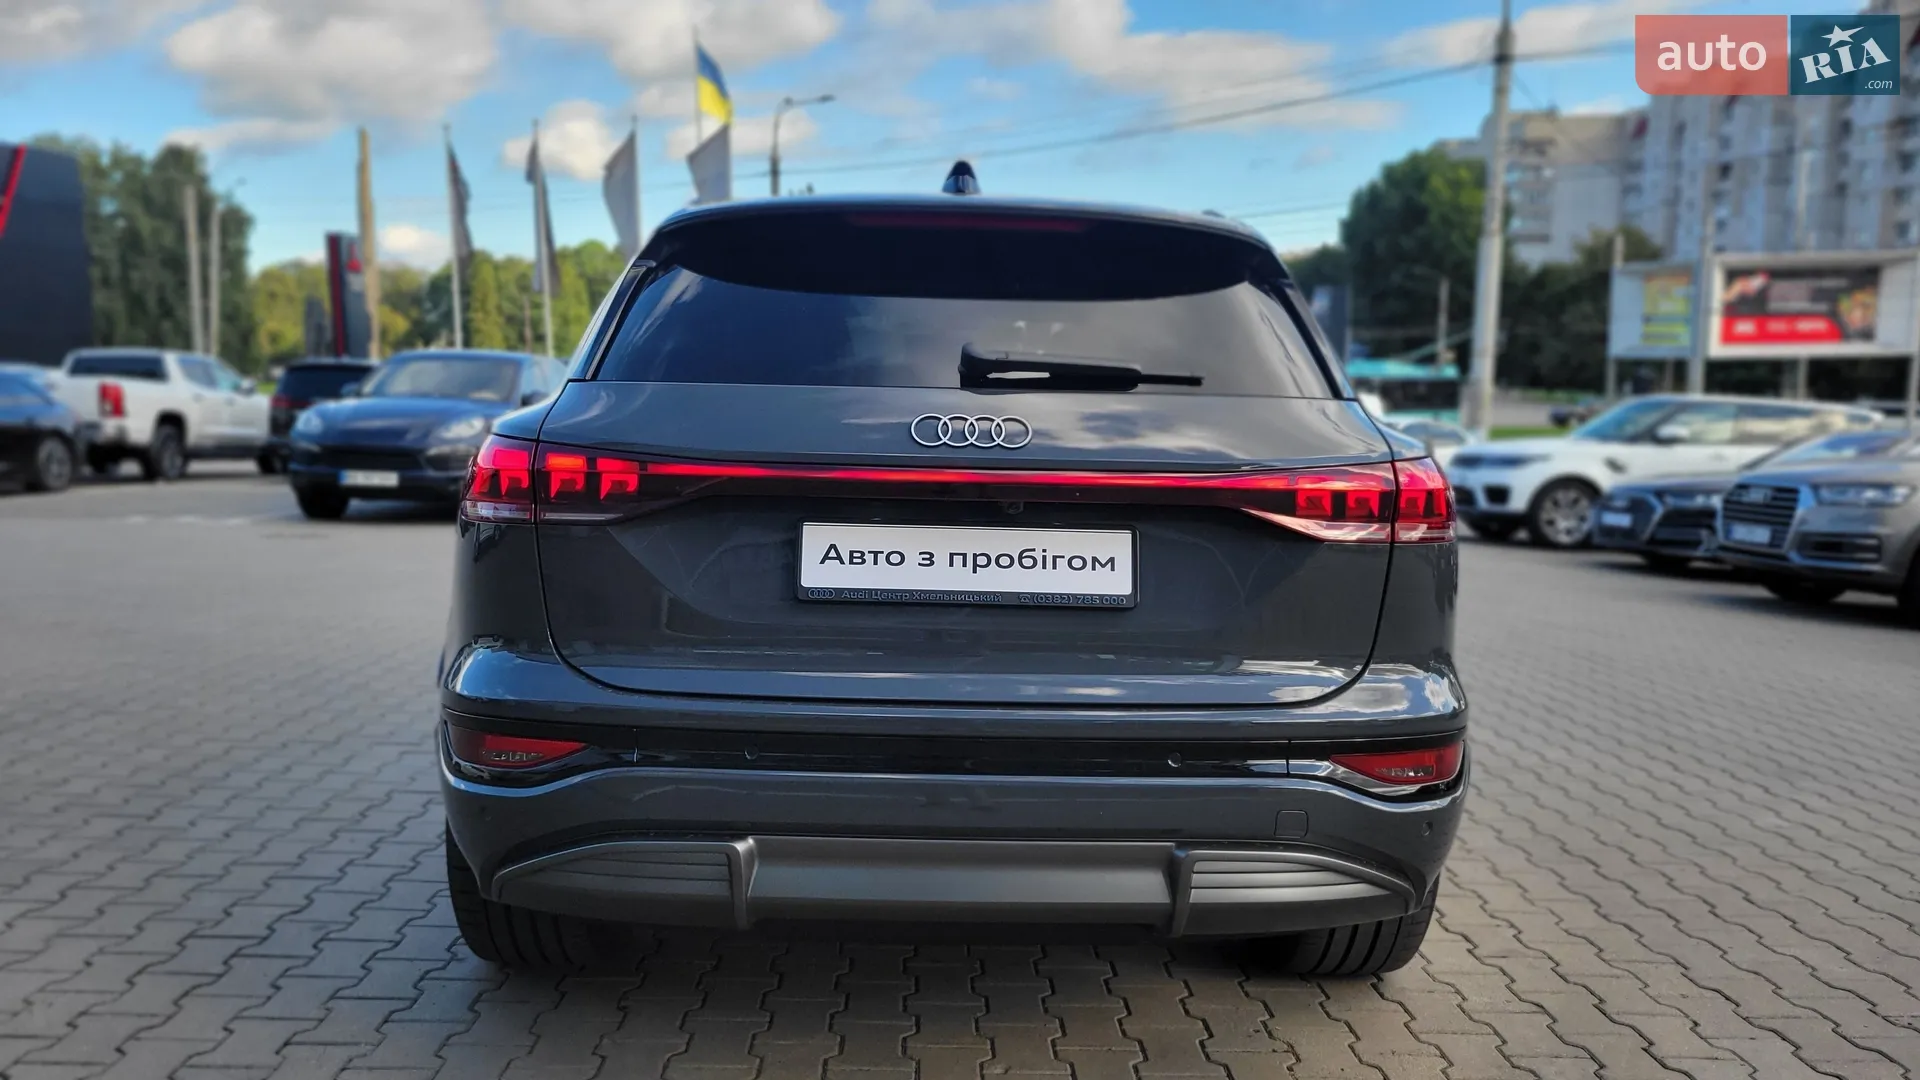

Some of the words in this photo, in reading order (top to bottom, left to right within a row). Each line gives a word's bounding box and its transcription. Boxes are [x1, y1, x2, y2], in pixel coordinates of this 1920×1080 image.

[819, 543, 906, 567] Авто
[917, 550, 936, 568] з
[948, 547, 1116, 574] пробігом
[841, 590, 869, 600] Audi
[871, 591, 910, 602] Центр
[912, 591, 1002, 603] Хмельницький
[1033, 593, 1073, 605] (0382)
[1076, 595, 1100, 605] 785
[1102, 595, 1127, 605] 000
